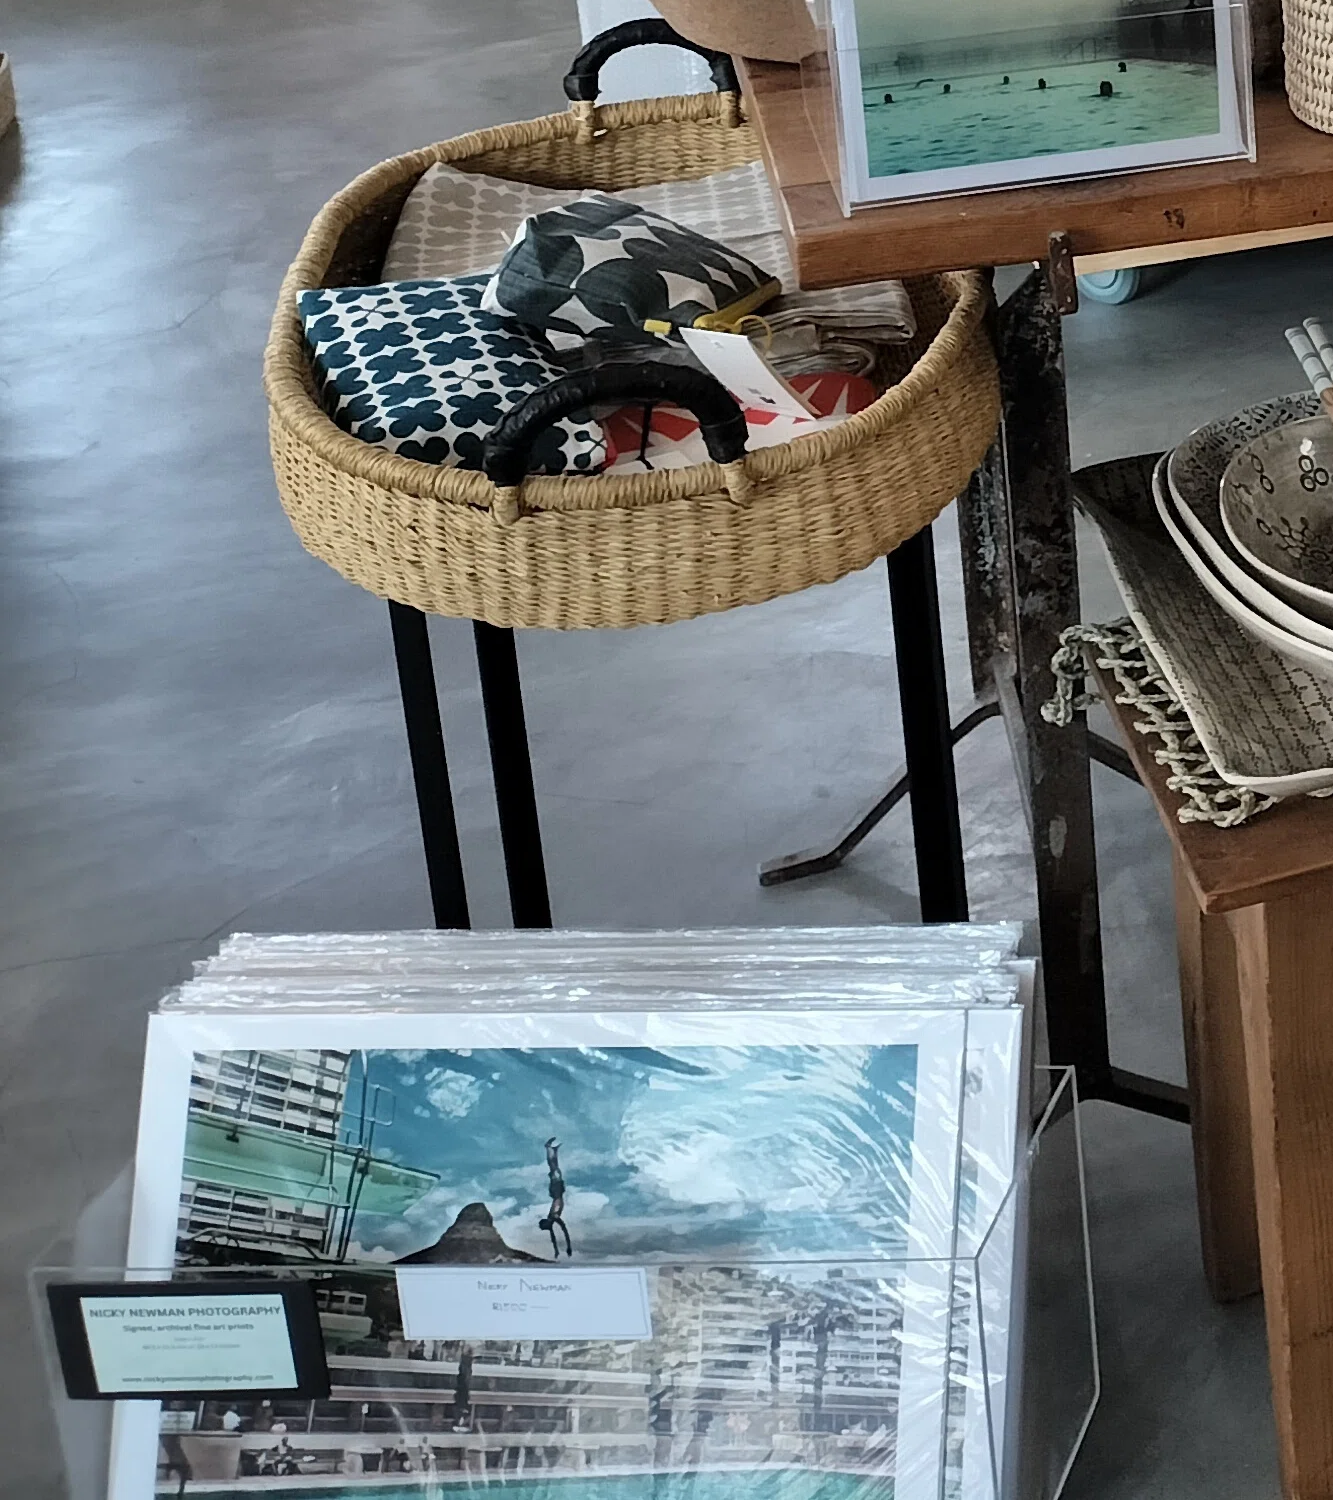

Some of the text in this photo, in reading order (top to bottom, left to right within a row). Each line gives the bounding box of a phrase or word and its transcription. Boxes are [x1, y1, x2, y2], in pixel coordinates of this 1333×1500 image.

[89, 1305, 281, 1318] NICKY NEWMAN PHOTOGRAPHY
[156, 1323, 192, 1332] archival
[193, 1322, 212, 1331] fine
[213, 1323, 226, 1331] art
[228, 1322, 254, 1332] prints
